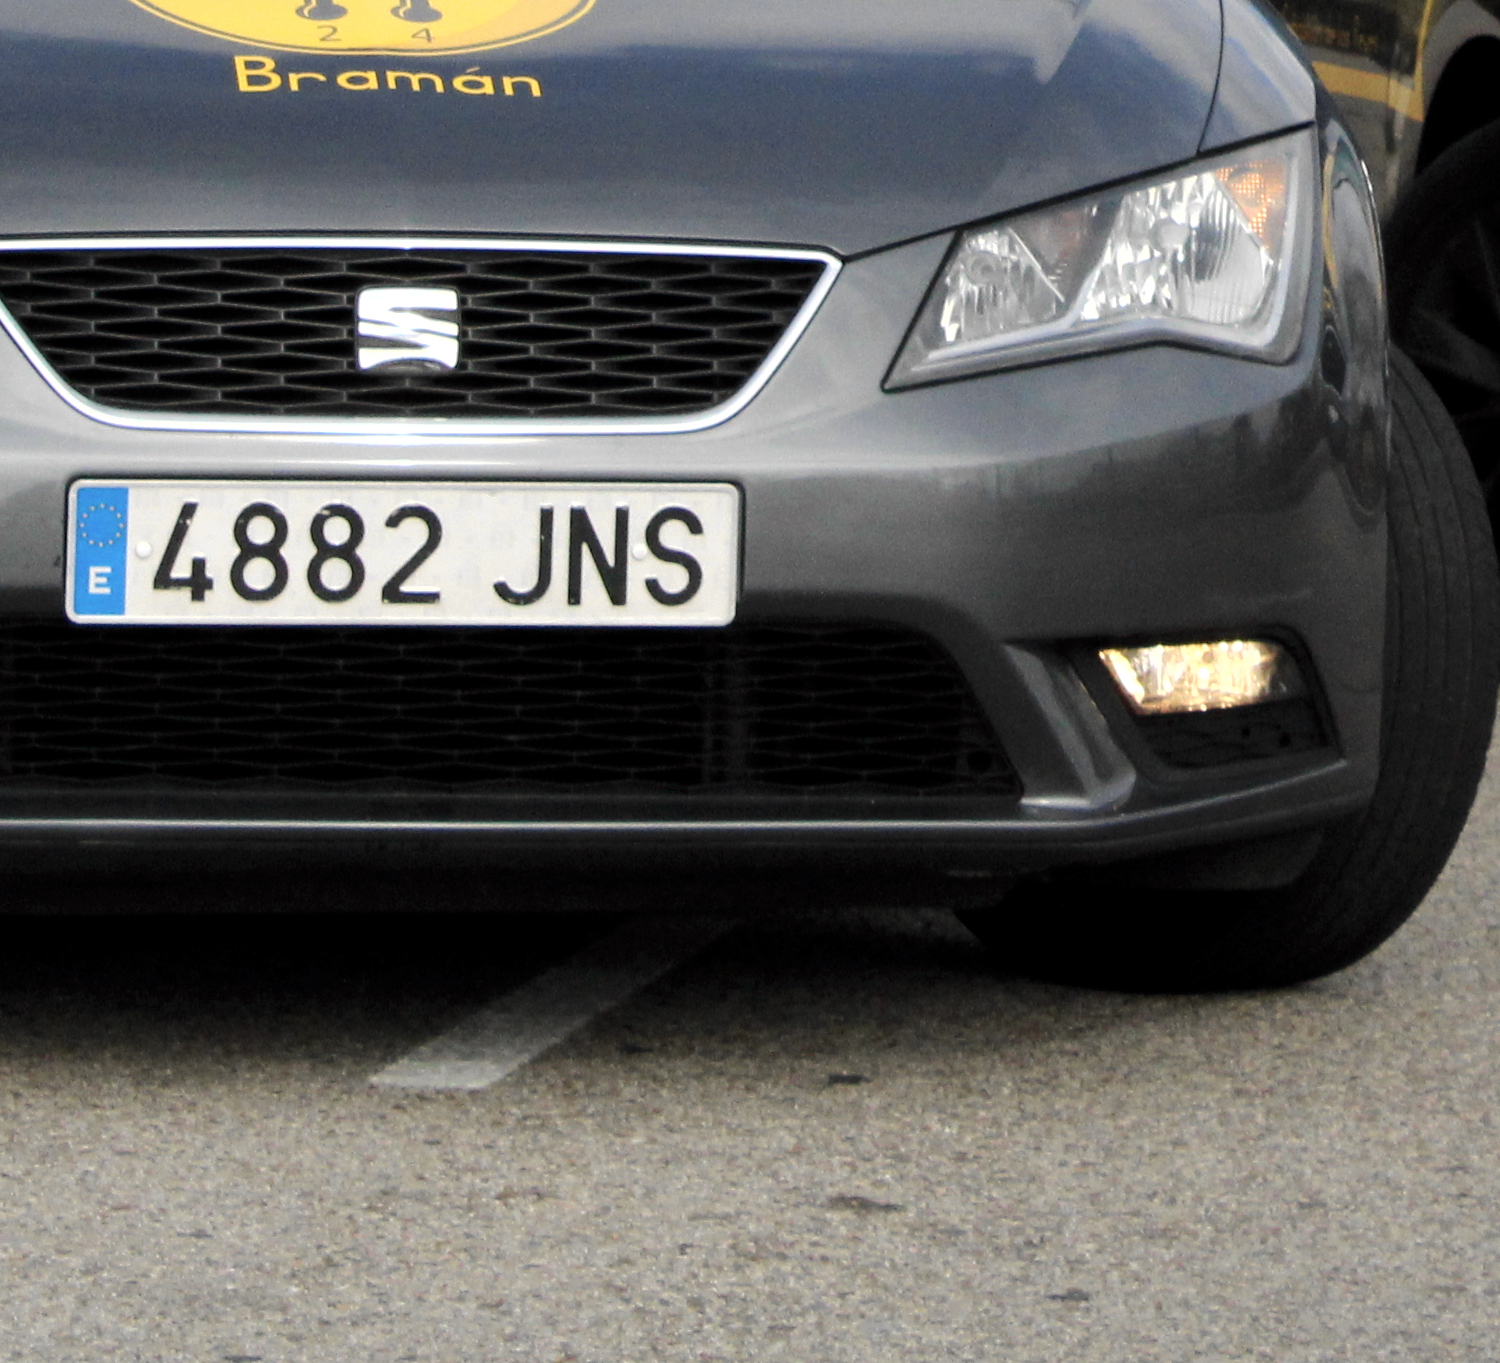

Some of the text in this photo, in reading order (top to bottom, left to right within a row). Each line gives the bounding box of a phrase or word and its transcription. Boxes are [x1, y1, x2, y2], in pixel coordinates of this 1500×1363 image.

[317, 24, 434, 43] 2 4
[234, 55, 542, 98] Bramán
[153, 501, 704, 607] 4882 JNS
[87, 566, 112, 594] E
